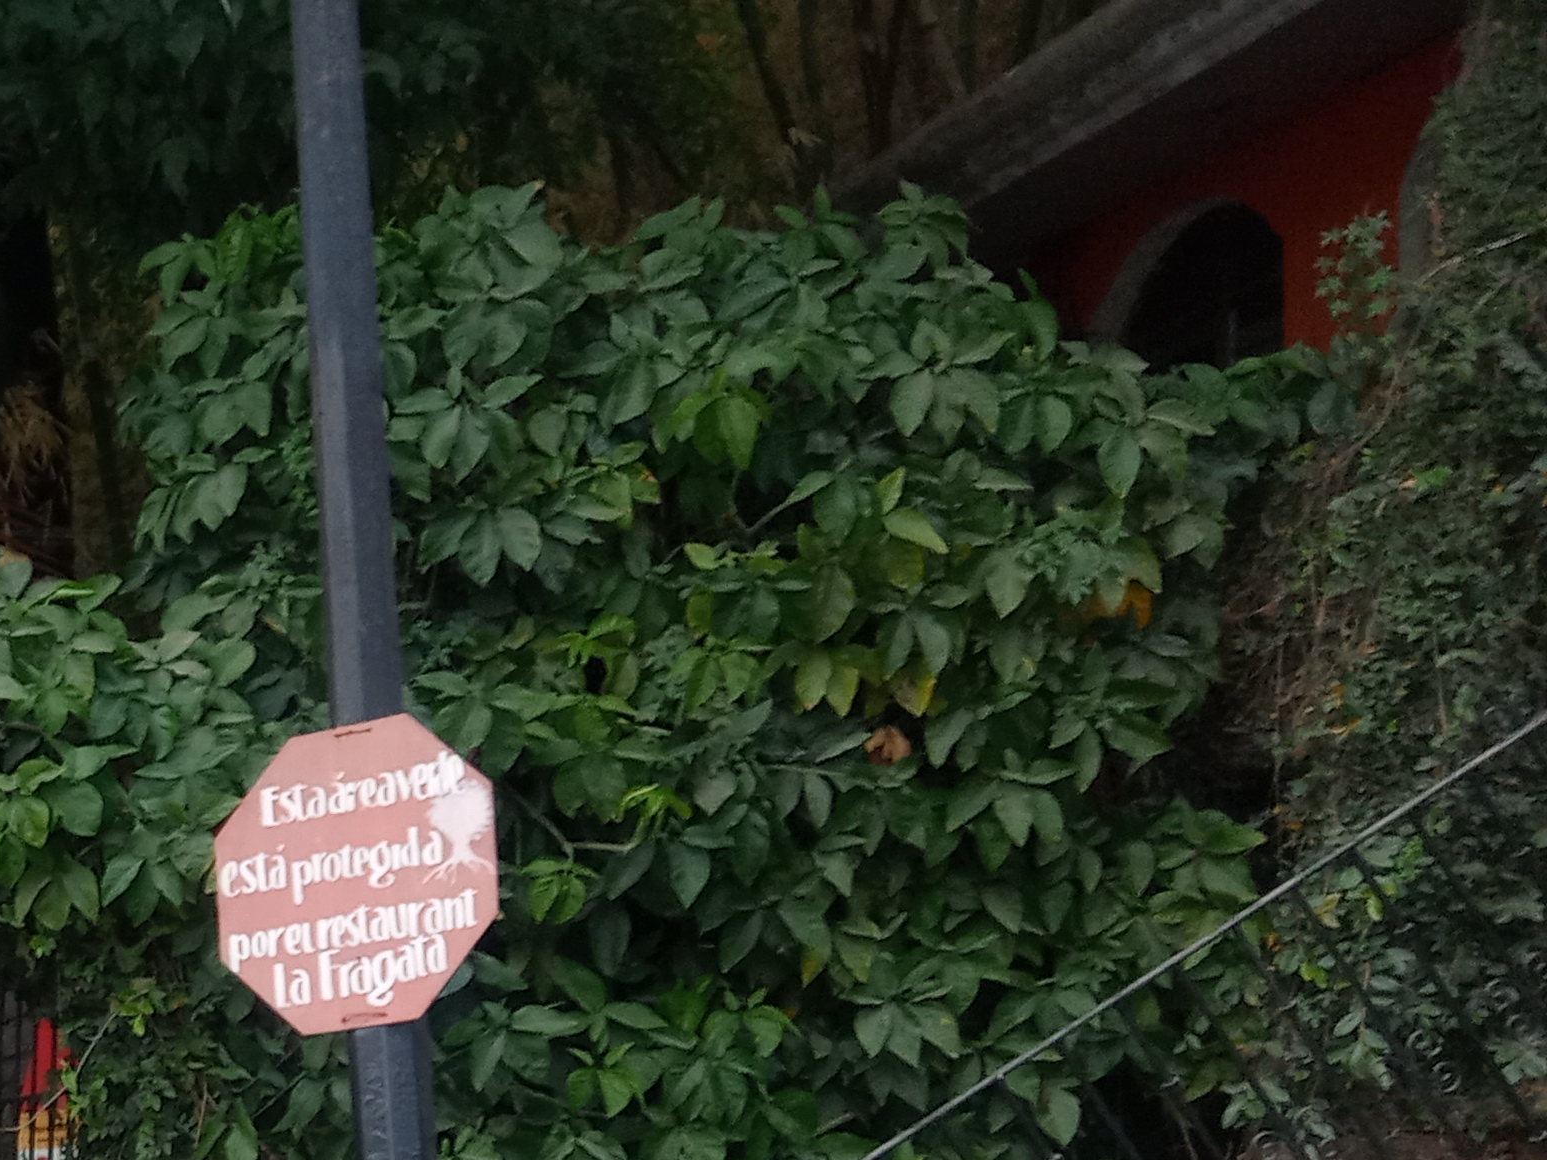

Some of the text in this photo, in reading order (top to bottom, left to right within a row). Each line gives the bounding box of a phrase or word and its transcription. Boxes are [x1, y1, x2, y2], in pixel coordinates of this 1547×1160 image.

[260, 783, 327, 828] Esta
[219, 826, 444, 906] está protegida
[228, 926, 286, 974] por
[316, 888, 478, 951] restaurant
[318, 933, 448, 1007] Fragata
